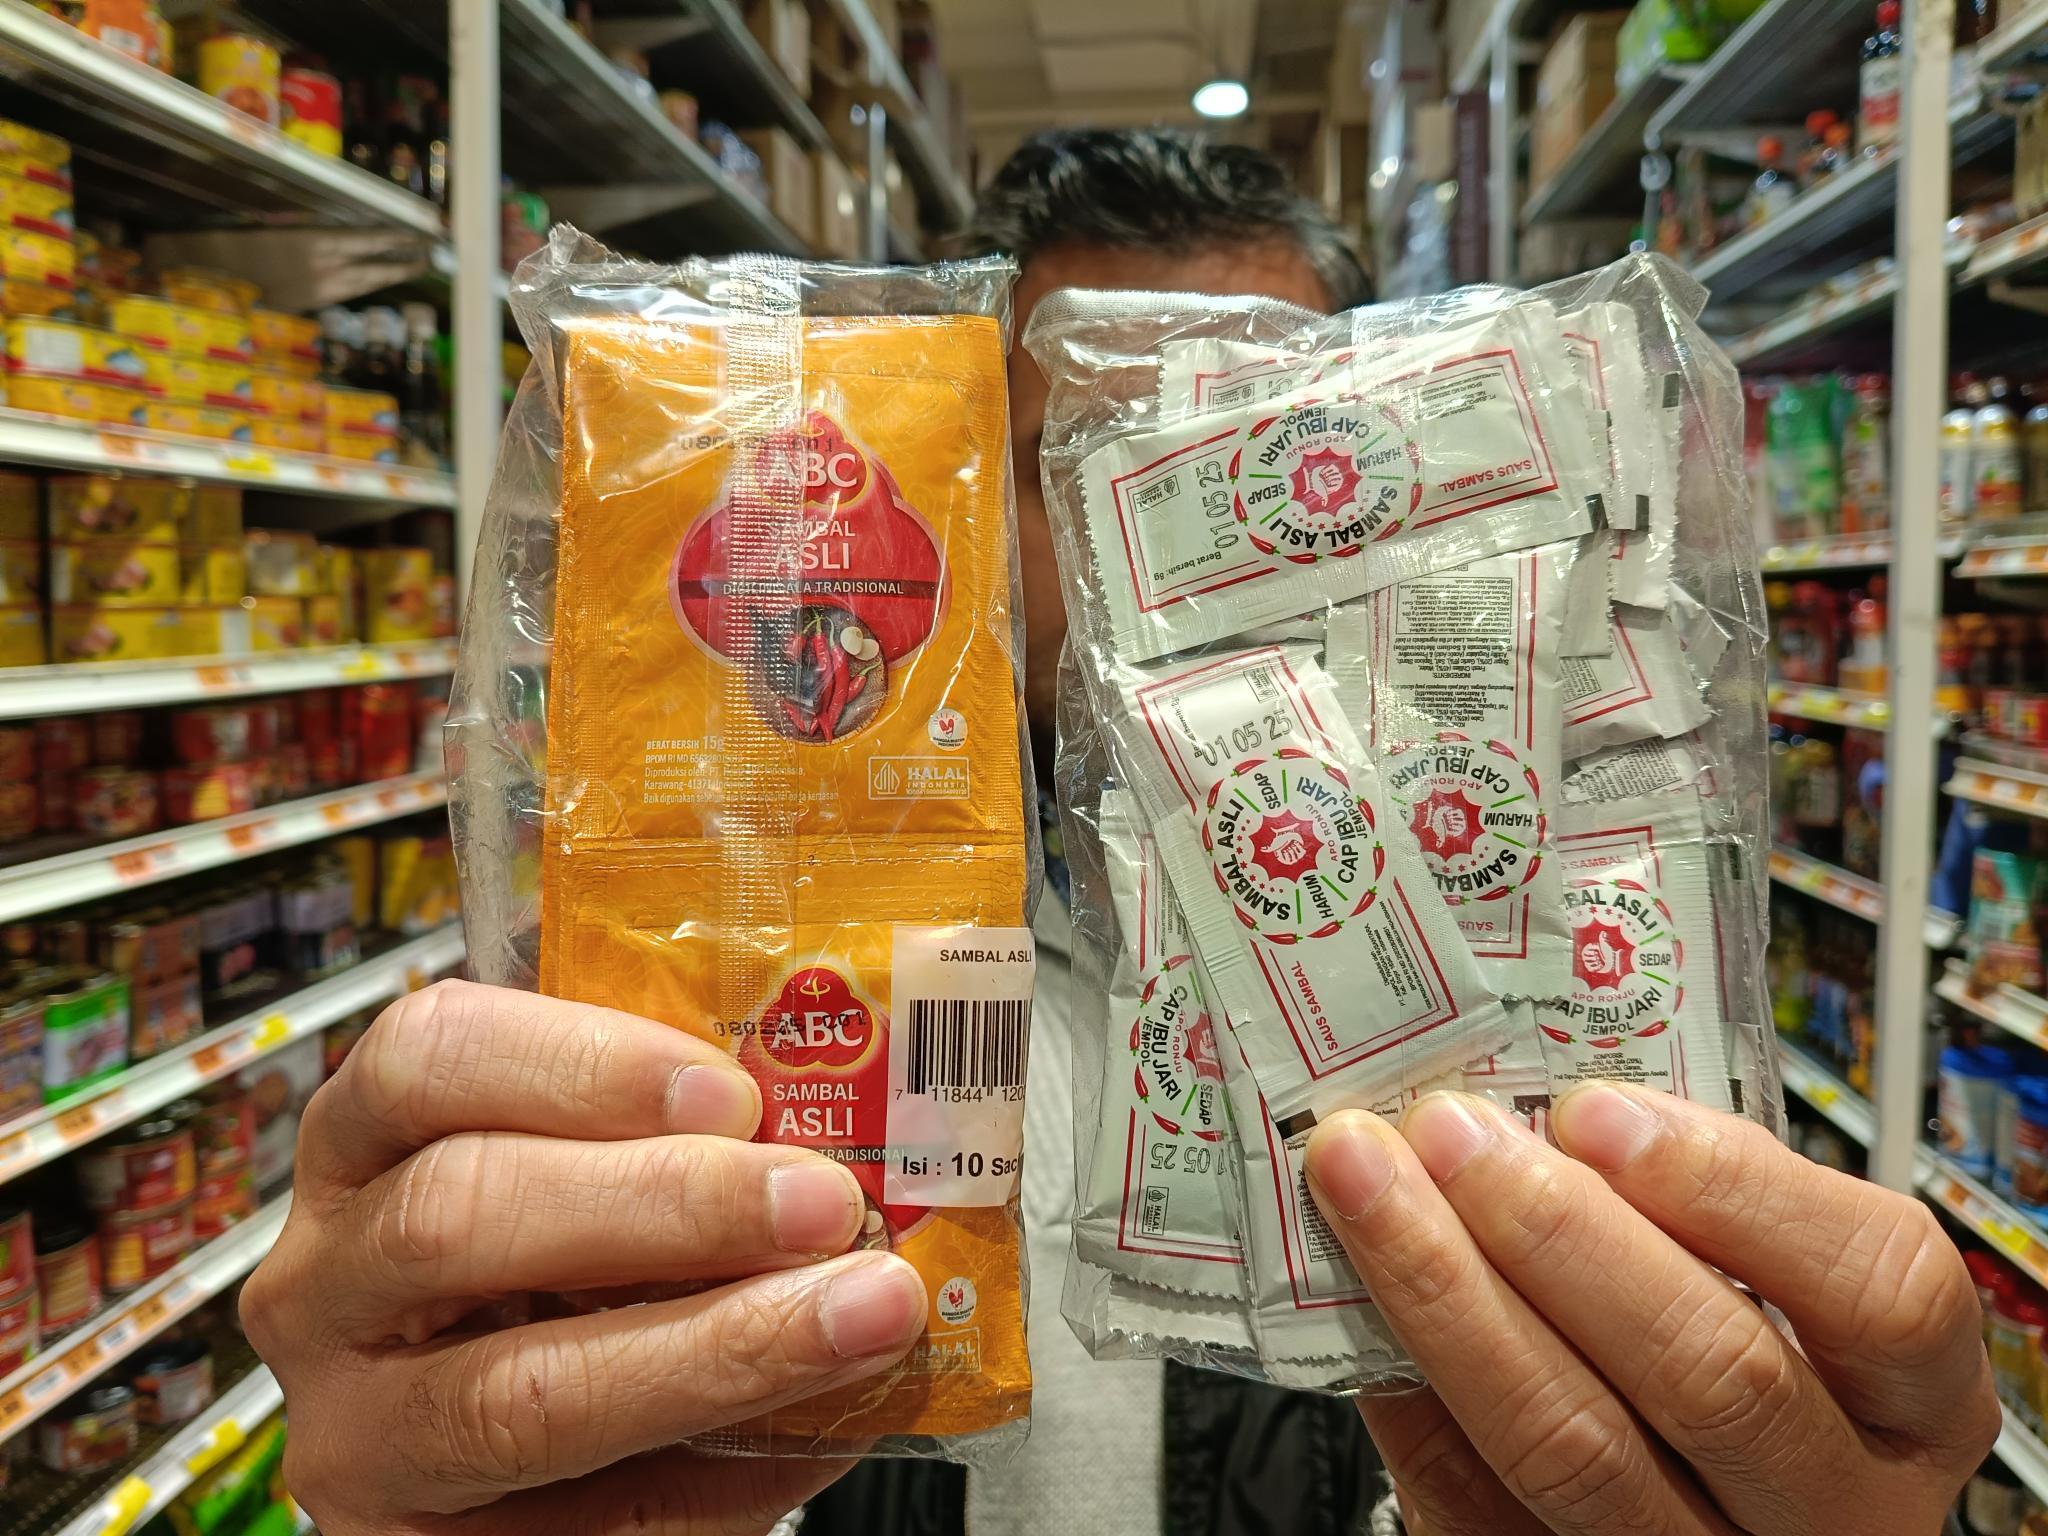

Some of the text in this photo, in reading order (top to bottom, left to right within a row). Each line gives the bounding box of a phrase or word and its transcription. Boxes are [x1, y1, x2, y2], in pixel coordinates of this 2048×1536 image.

[1279, 406, 1329, 428] JEMPOL
[1258, 416, 1370, 467] CAP IBU JARI
[1357, 446, 1402, 471] HARUM
[1438, 459, 1533, 493] SAUS SAMBAL
[1248, 482, 1287, 505] SEDAP
[769, 519, 856, 538] SAMBAL
[1269, 485, 1398, 549] SAMBAL ASLI
[775, 543, 851, 570] ASLI
[1197, 551, 1223, 564] Berat
[815, 580, 905, 595] TRADISIONAL
[646, 740, 670, 750] BERAT
[671, 740, 699, 750] BERSIH
[1201, 708, 1293, 767] 01 05 25
[645, 766, 686, 779] Diproduksi
[907, 767, 965, 780] HALAL
[1435, 757, 1470, 776] IBU
[1470, 765, 1510, 794] CAP
[1254, 772, 1282, 810] SEDAP
[1459, 778, 1483, 791] APO
[1339, 790, 1368, 840] JEMPOL
[1484, 812, 1533, 827] HARUM
[1296, 776, 1359, 884] CAP IBU JARI
[1305, 804, 1338, 862] APO RONJU
[1217, 798, 1292, 921] SAMBAL ASLI
[1432, 848, 1518, 893] SAMBAL
[1570, 855, 1627, 870] SAMBAL
[1302, 874, 1335, 920] HARUM
[1563, 888, 1658, 931] BAL ASLI
[1458, 920, 1494, 931] SAUS
[940, 949, 1003, 963] SAMBAL
[1639, 952, 1672, 967] SEDAP
[1290, 960, 1339, 1051] SAUS SAMBAL
[1571, 991, 1595, 1002] APO
[1587, 1005, 1620, 1024] IBU
[1625, 986, 1663, 1020] JARI
[770, 1009, 863, 1050] ABC
[1140, 1015, 1153, 1067] JEMPOL
[1582, 1021, 1635, 1036] JEMPOL
[1151, 985, 1188, 1101] CAP IBU JARI
[1172, 1036, 1183, 1073] RONJU
[773, 1083, 859, 1101] SAMBAL
[895, 1088, 904, 1101] 7
[931, 1086, 984, 1103] 11844
[1198, 1083, 1214, 1126] SEDAP
[777, 1107, 853, 1137] ASLI
[902, 1156, 928, 1176] Isi
[951, 1151, 984, 1178] 10
[991, 1156, 1021, 1177] Sac
[1150, 1142, 1178, 1170] 25
[1183, 1146, 1211, 1174] 05
[1151, 1205, 1162, 1233] HALAL
[915, 1338, 976, 1360] HALAL
